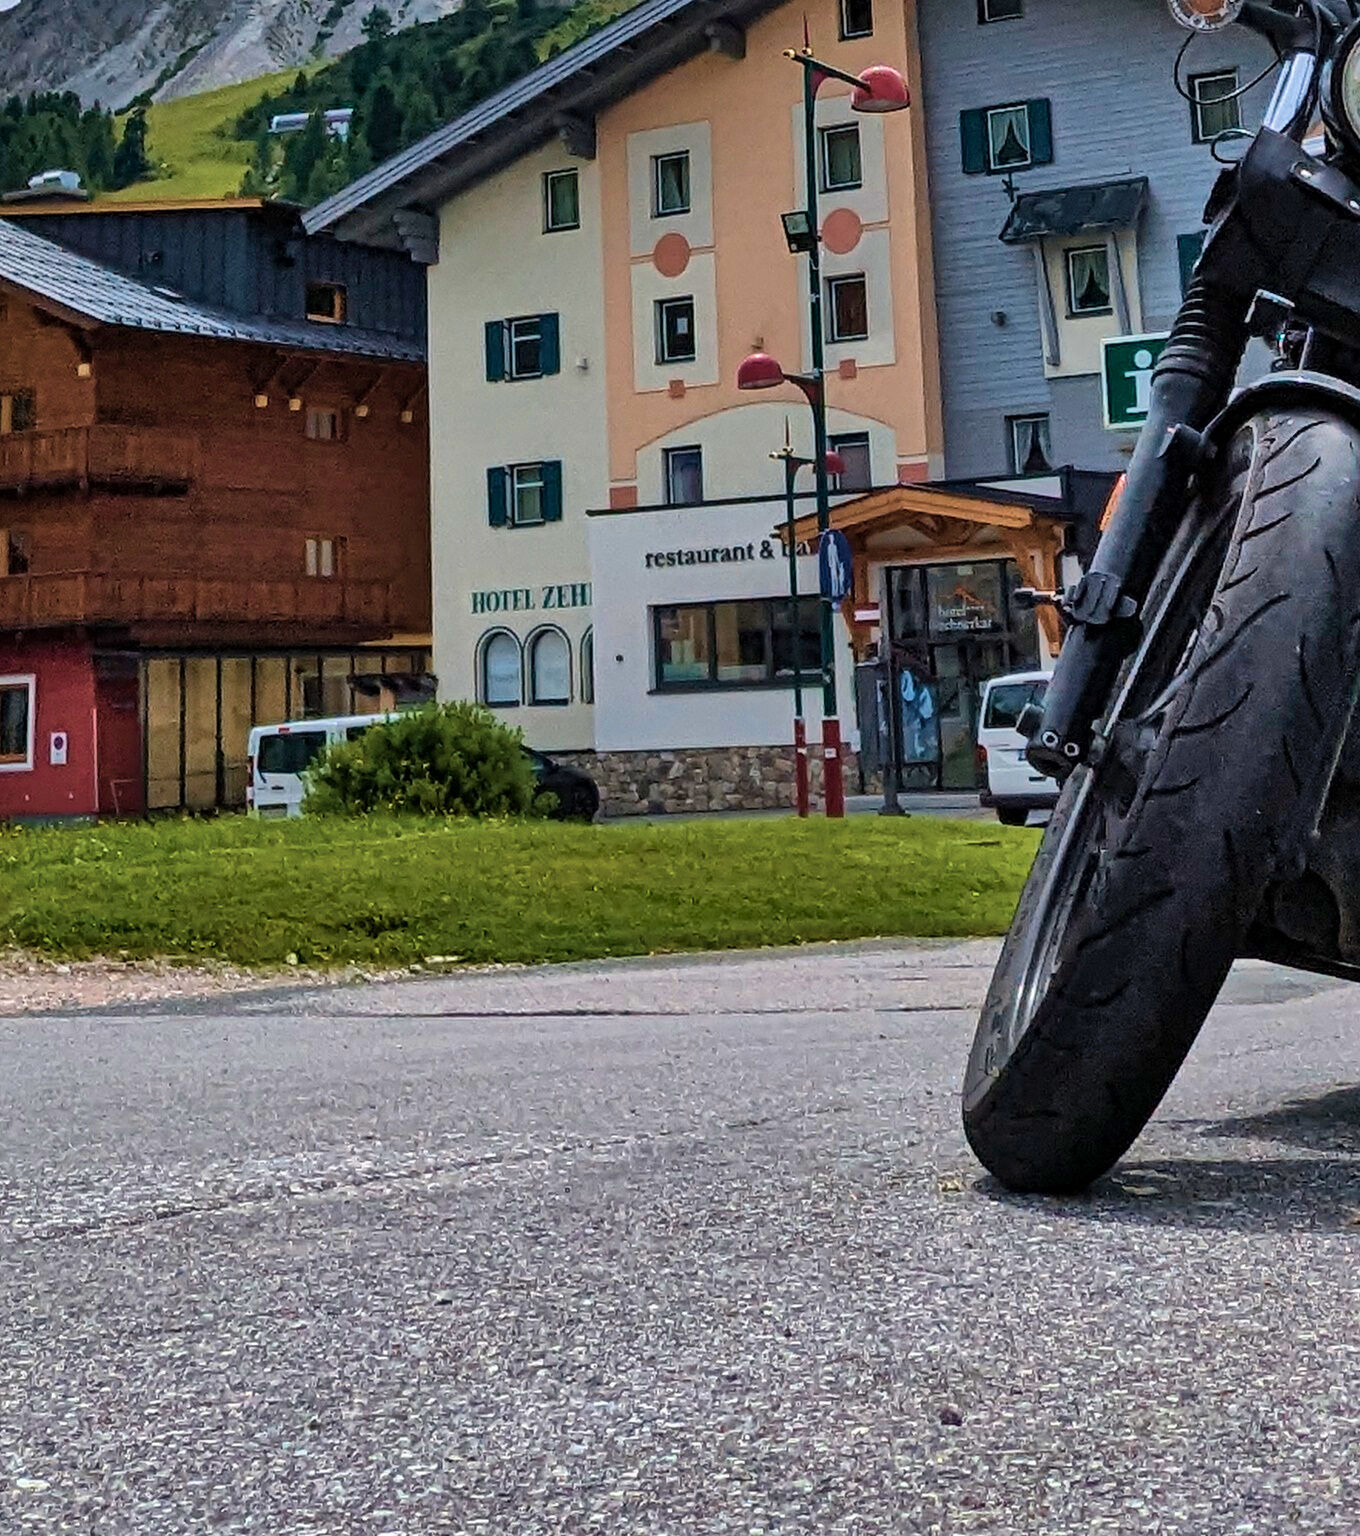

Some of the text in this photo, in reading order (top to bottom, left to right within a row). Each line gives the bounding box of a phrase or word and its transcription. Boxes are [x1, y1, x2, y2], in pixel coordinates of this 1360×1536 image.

[644, 542, 754, 569] restaurant
[759, 539, 775, 560] &
[470, 582, 592, 615] HOTEL ZEH
